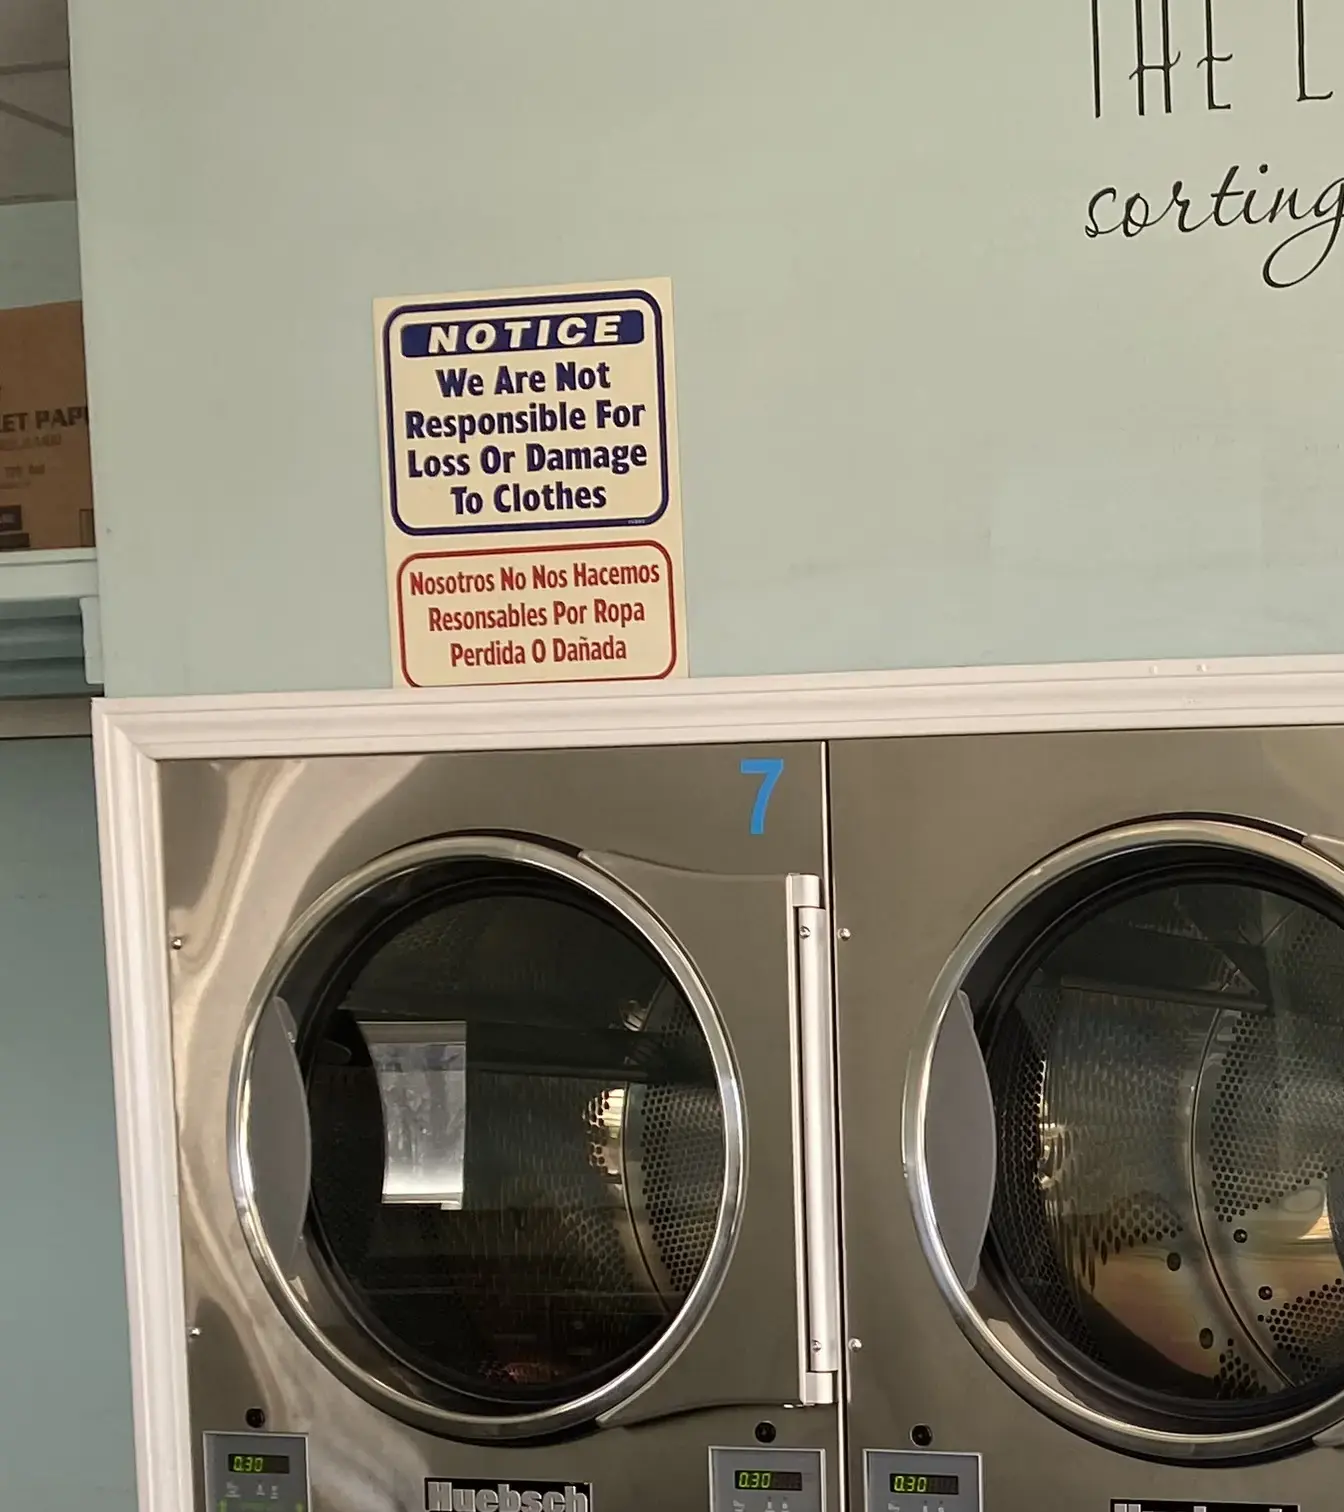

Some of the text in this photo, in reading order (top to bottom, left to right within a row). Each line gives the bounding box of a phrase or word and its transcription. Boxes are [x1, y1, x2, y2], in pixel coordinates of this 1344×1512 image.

[428, 315, 622, 354] NOTICE
[435, 361, 611, 398] We Are Not
[404, 399, 647, 443] Responsible For
[407, 443, 648, 479] Loss Or Damage
[449, 480, 607, 516] To Clothes
[410, 562, 660, 596] Nosotros No Nos Hacemos
[428, 598, 645, 631] Resonsables Por Ropa
[450, 635, 628, 667] Perdida O Dañada
[740, 759, 784, 835] 7
